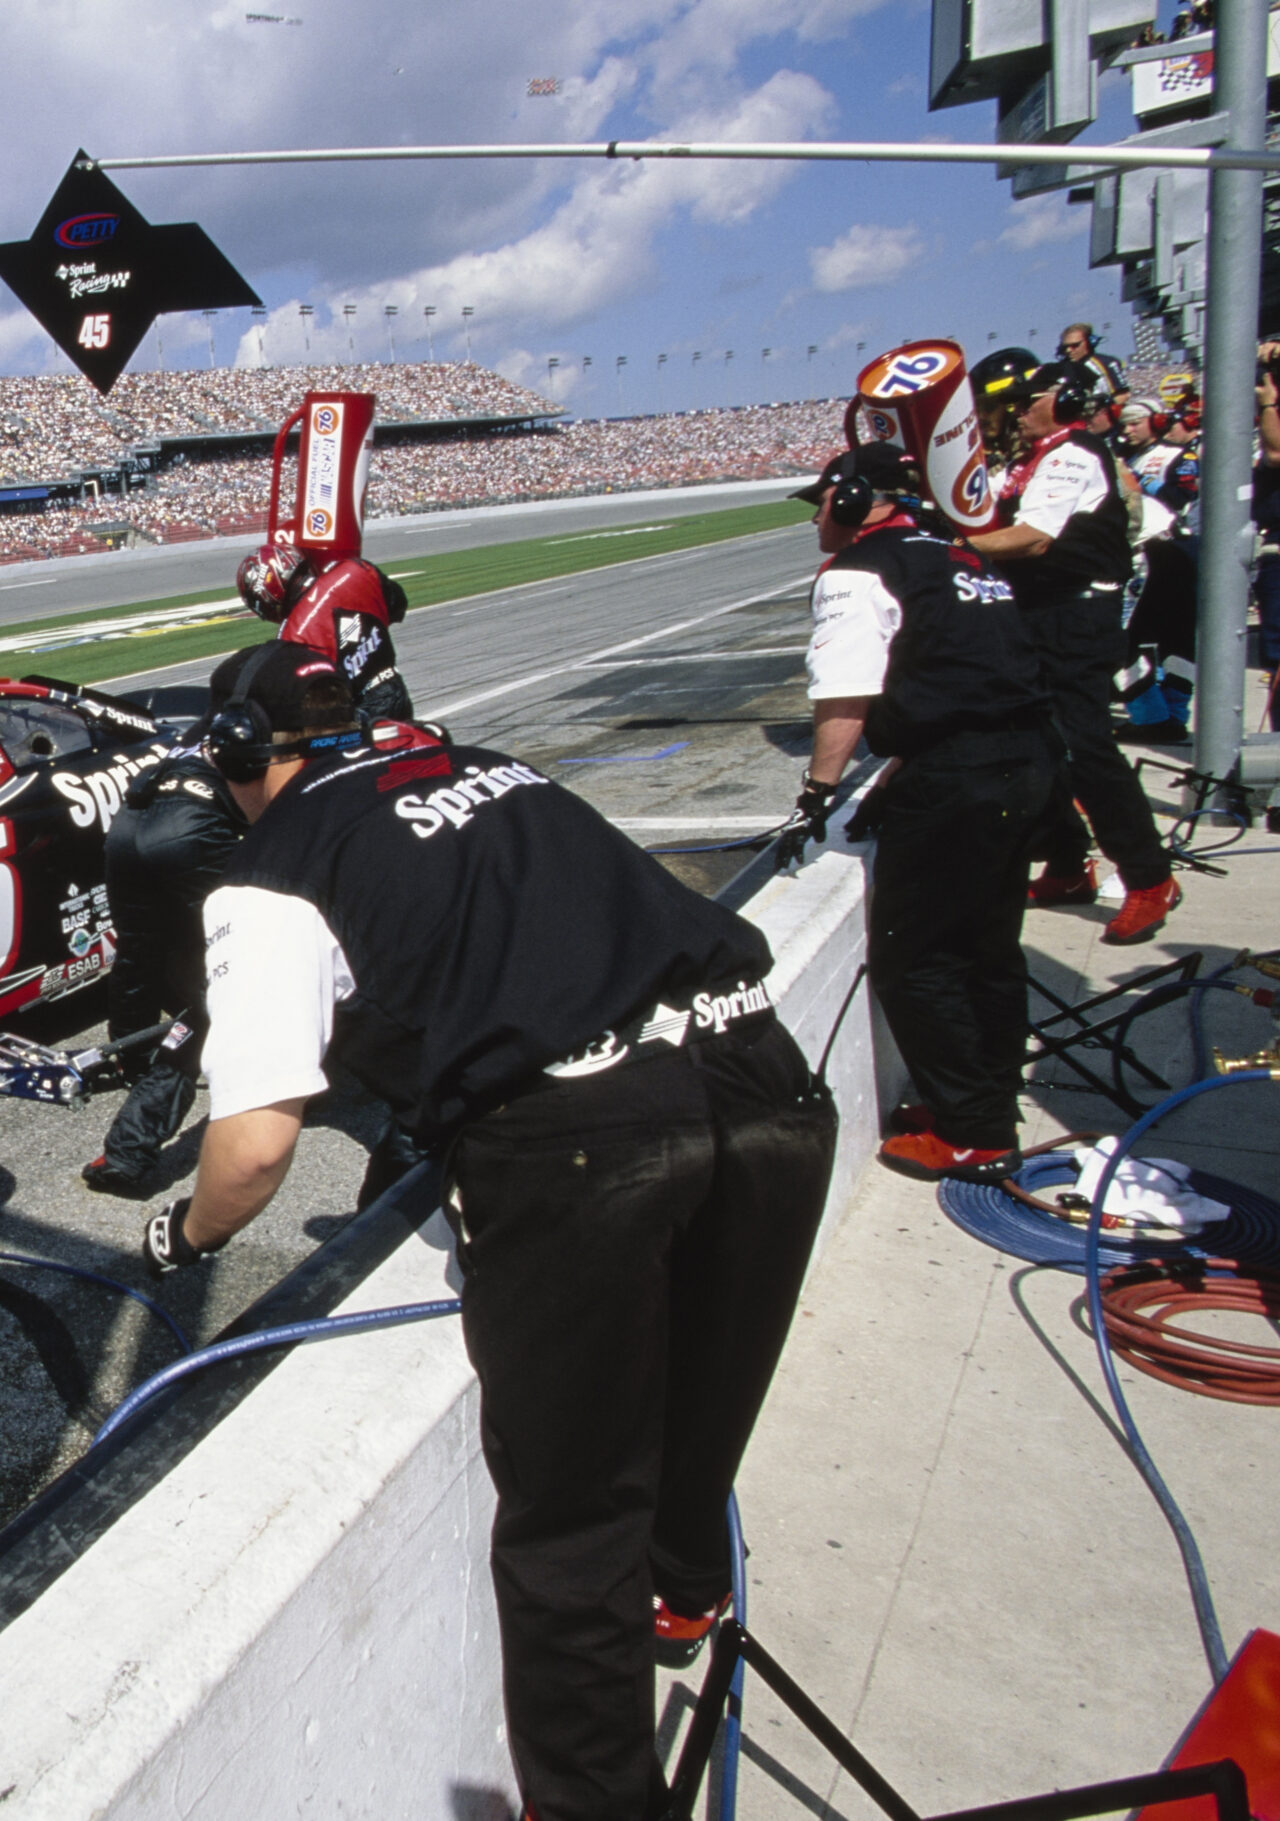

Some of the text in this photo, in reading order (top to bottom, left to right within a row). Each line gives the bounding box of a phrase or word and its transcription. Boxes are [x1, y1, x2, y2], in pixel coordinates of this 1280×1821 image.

[70, 219, 120, 241] PETTY
[69, 262, 97, 278] Sprint
[69, 273, 111, 299] Racing
[78, 314, 111, 349] 45
[872, 351, 948, 399] 76
[318, 410, 333, 432] 76
[308, 439, 319, 506] OFFICIAL FUEL
[311, 512, 326, 534] 76
[274, 529, 295, 545] 2
[343, 626, 382, 680] Sprint
[106, 706, 158, 734] Sprint
[395, 761, 550, 838] Sprint
[61, 909, 91, 934] BASF
[67, 953, 101, 980] ESAB
[692, 980, 773, 1034] Sprint
